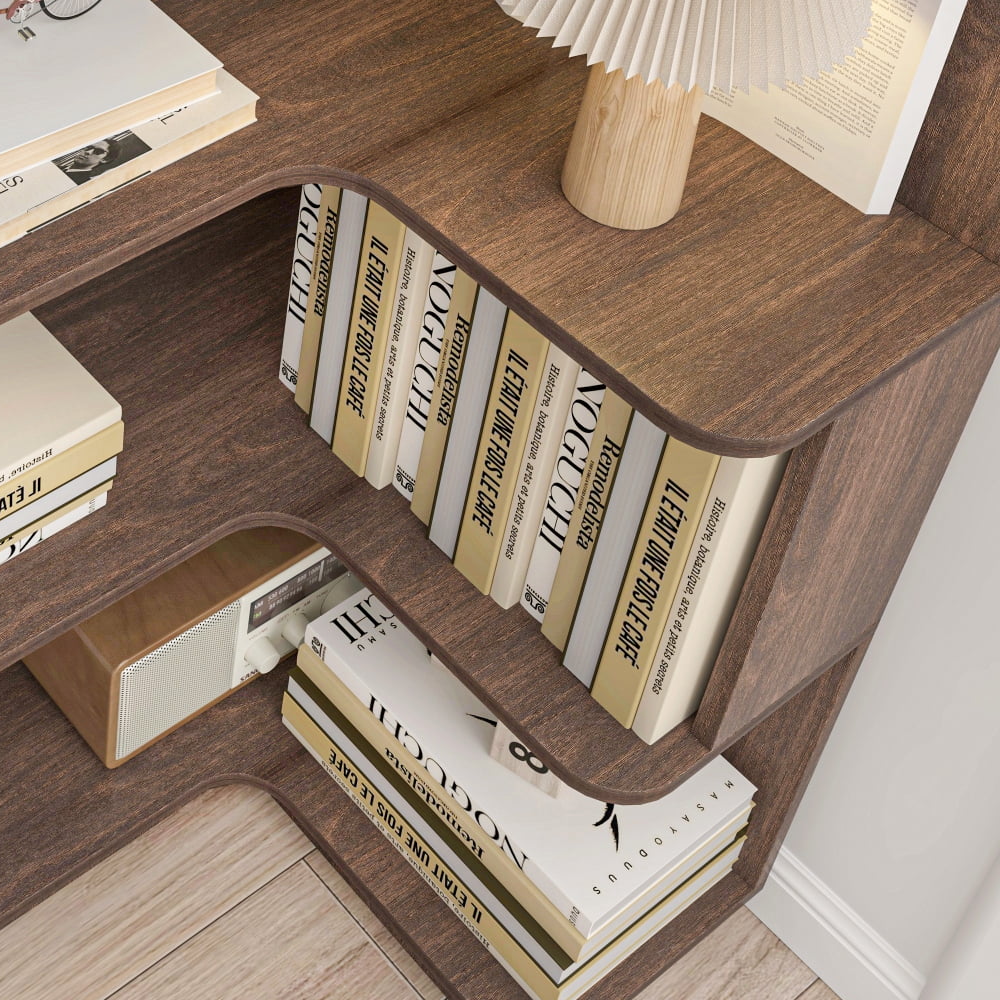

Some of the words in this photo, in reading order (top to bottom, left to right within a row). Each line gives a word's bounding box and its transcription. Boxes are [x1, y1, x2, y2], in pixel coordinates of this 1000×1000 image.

[370, 235, 389, 257] IL
[364, 254, 389, 301] ÉTAIT
[359, 294, 380, 332] UNE
[354, 322, 374, 366] FOIS
[351, 357, 369, 385] LE
[540, 364, 560, 408] Histoire,
[346, 377, 365, 419] CAFÉ
[528, 410, 549, 461] botanique,
[520, 486, 529, 498] et
[523, 462, 534, 485] arts
[576, 434, 621, 550] Remodelista
[666, 478, 690, 502] IL
[512, 494, 526, 526] petits
[652, 498, 688, 550] ÉTAIT
[702, 496, 726, 543] Histoire,
[505, 525, 520, 560] secrets
[641, 538, 671, 581] UNE
[683, 544, 710, 595] botanique,
[632, 572, 661, 616] FOIS
[678, 597, 690, 621] arts
[625, 603, 649, 634] LE
[674, 619, 682, 633] et
[616, 624, 644, 669] CAFÉ
[663, 627, 680, 660] petits
[652, 659, 669, 695] secrets
